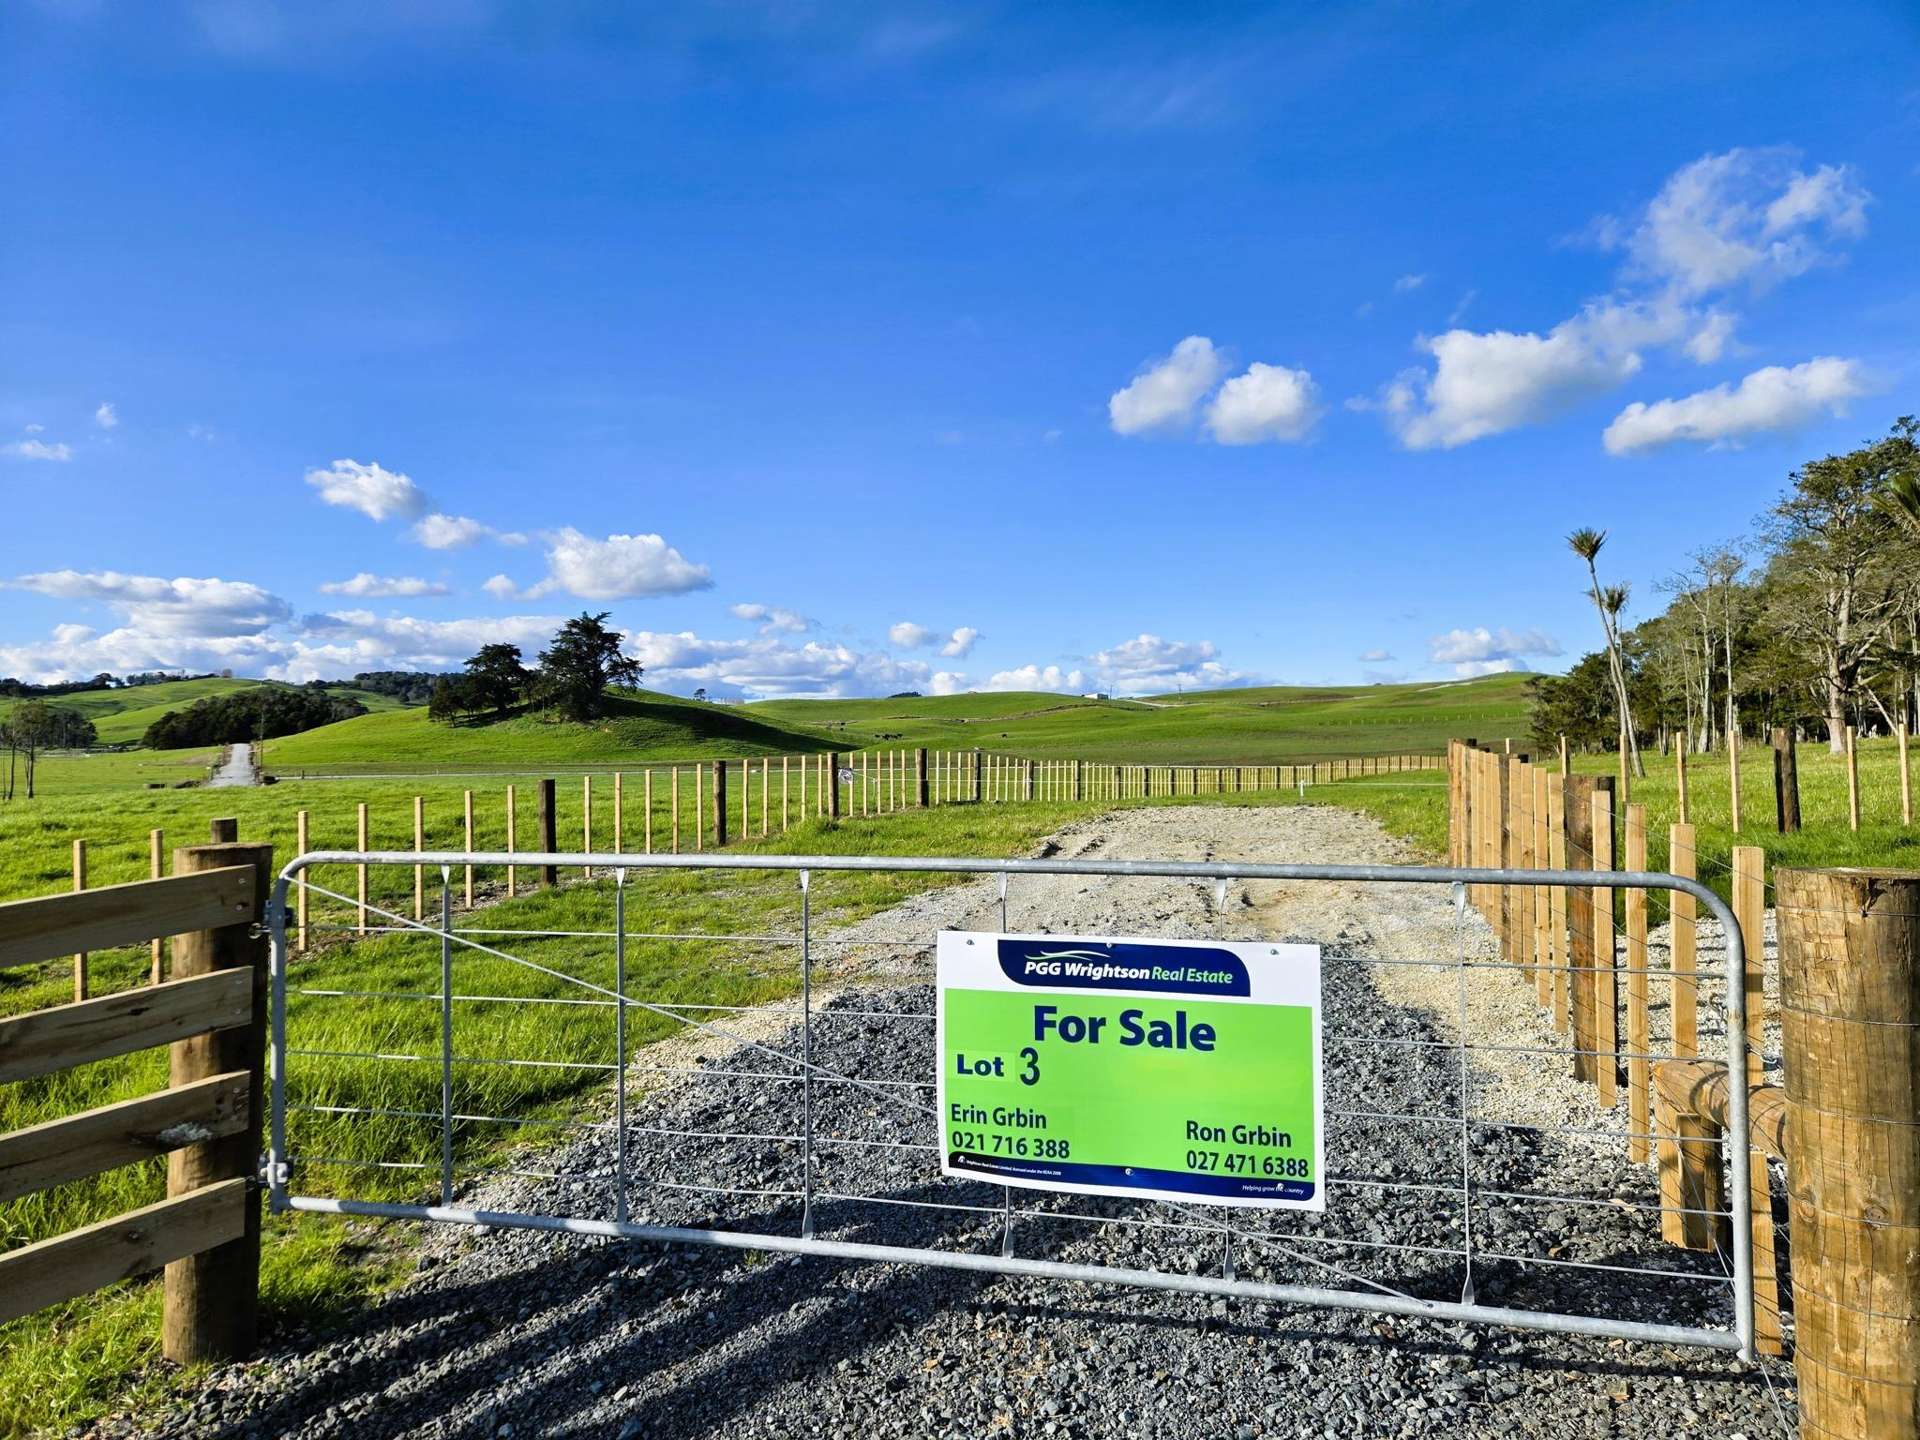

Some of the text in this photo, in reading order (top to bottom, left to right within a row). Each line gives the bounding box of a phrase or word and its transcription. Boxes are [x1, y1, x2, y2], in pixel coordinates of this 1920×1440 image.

[1024, 961, 1234, 984] PGG Wrightson Real Estate
[1034, 1005, 1217, 1052] For Sale
[957, 1047, 1040, 1086] Lot 3
[951, 1103, 1047, 1129] Erin Grbin
[952, 1130, 1070, 1159] 021 716 388
[1186, 1120, 1292, 1148] Ron Grbin
[1186, 1150, 1309, 1178] 027 471 6388
